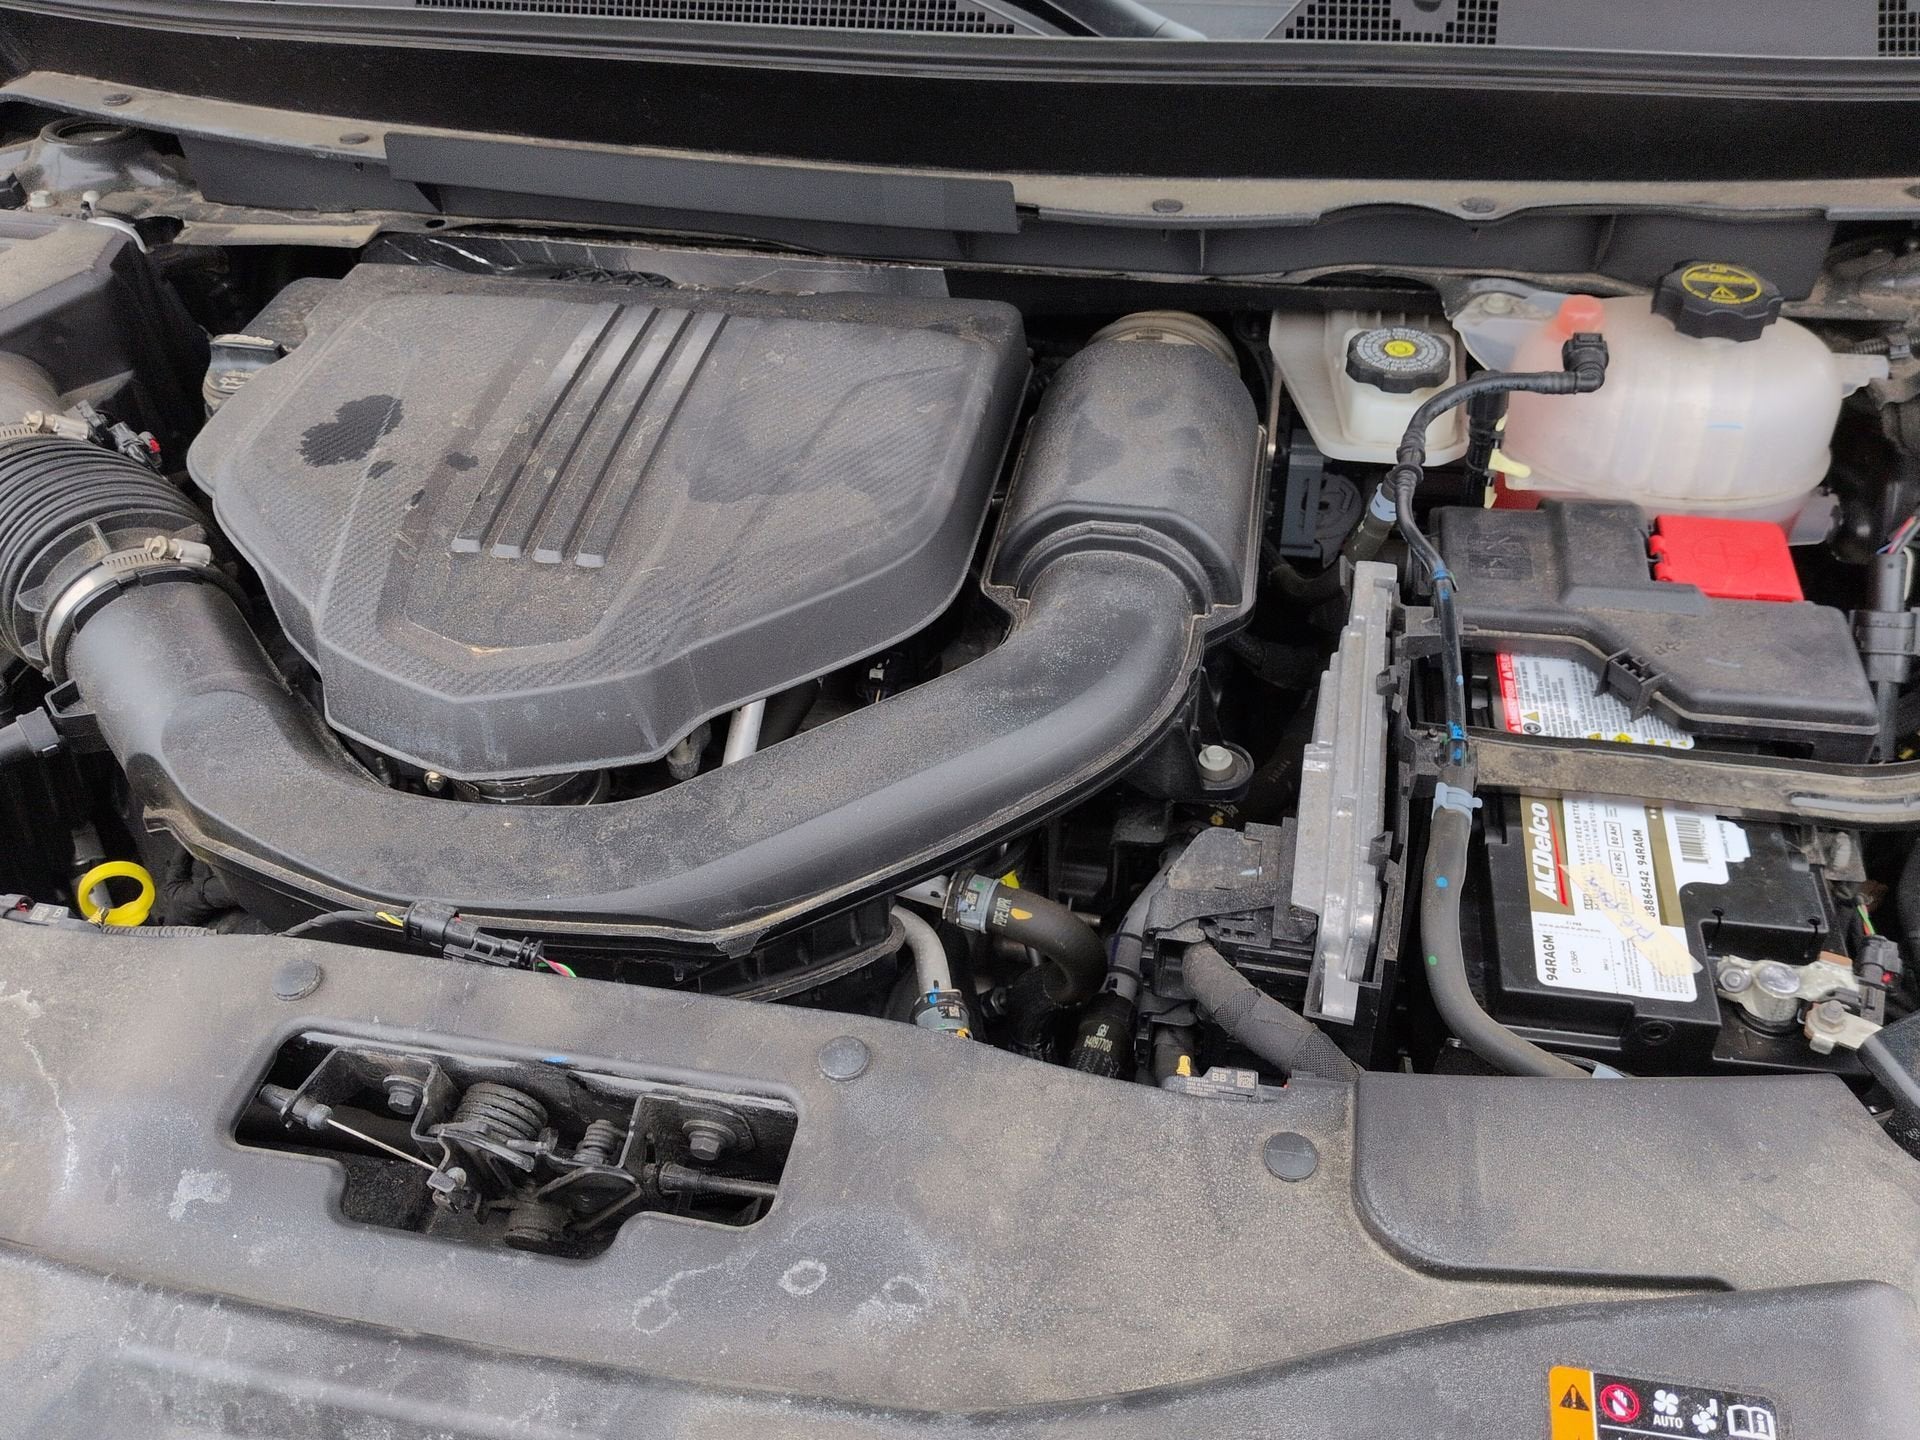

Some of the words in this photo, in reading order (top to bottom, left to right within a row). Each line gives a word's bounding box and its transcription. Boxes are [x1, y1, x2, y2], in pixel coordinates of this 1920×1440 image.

[1529, 802, 1557, 901] ACDelco
[1613, 851, 1621, 861] RC
[1634, 830, 1649, 866] 94RAGM
[1542, 934, 1558, 981] 94RAGM
[1653, 1414, 1683, 1429] AUTO
